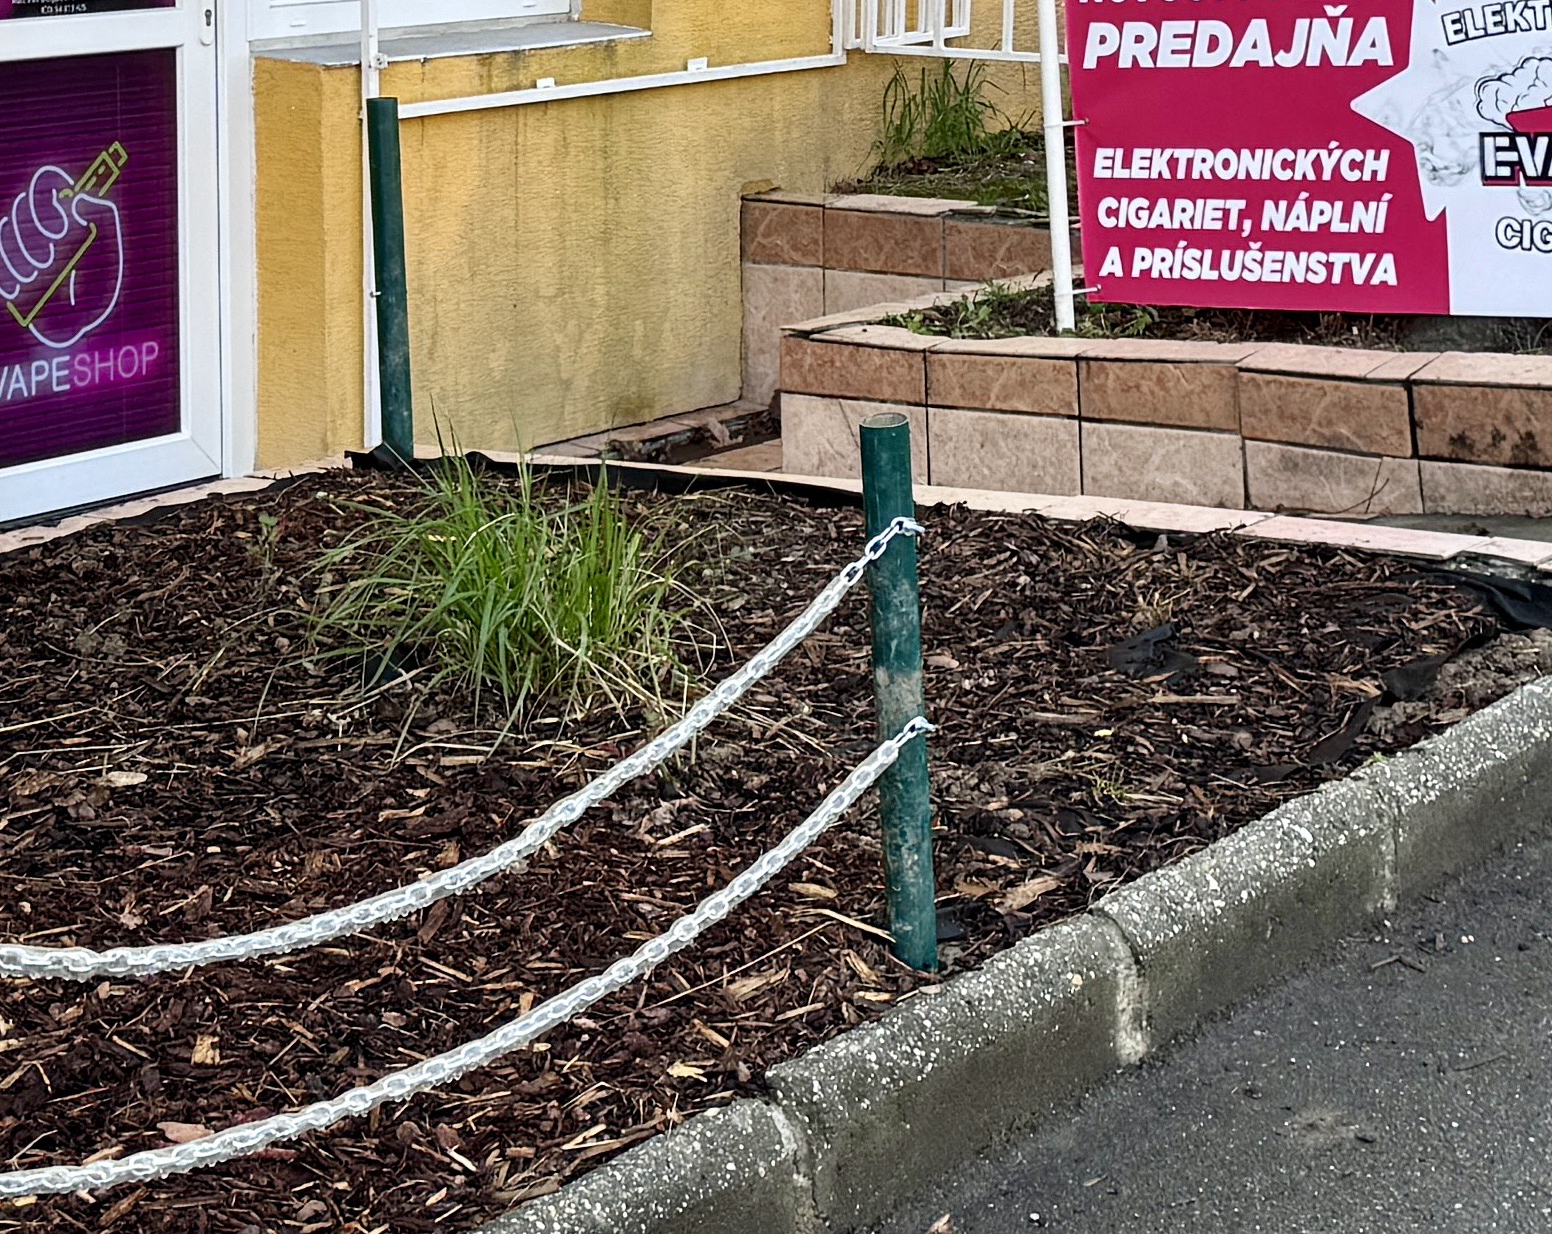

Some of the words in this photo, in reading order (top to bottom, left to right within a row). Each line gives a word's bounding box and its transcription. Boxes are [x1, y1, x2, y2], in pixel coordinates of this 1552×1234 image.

[1082, 4, 1394, 70] PREDAJŇA
[1093, 141, 1390, 182] ELEKTRONICKÝCH
[1097, 198, 1252, 239] CIGARIET,
[1260, 193, 1393, 233] NÁPLNÍ
[1098, 246, 1124, 278] A
[1131, 243, 1398, 286] PRÍSLUŠENSTVA
